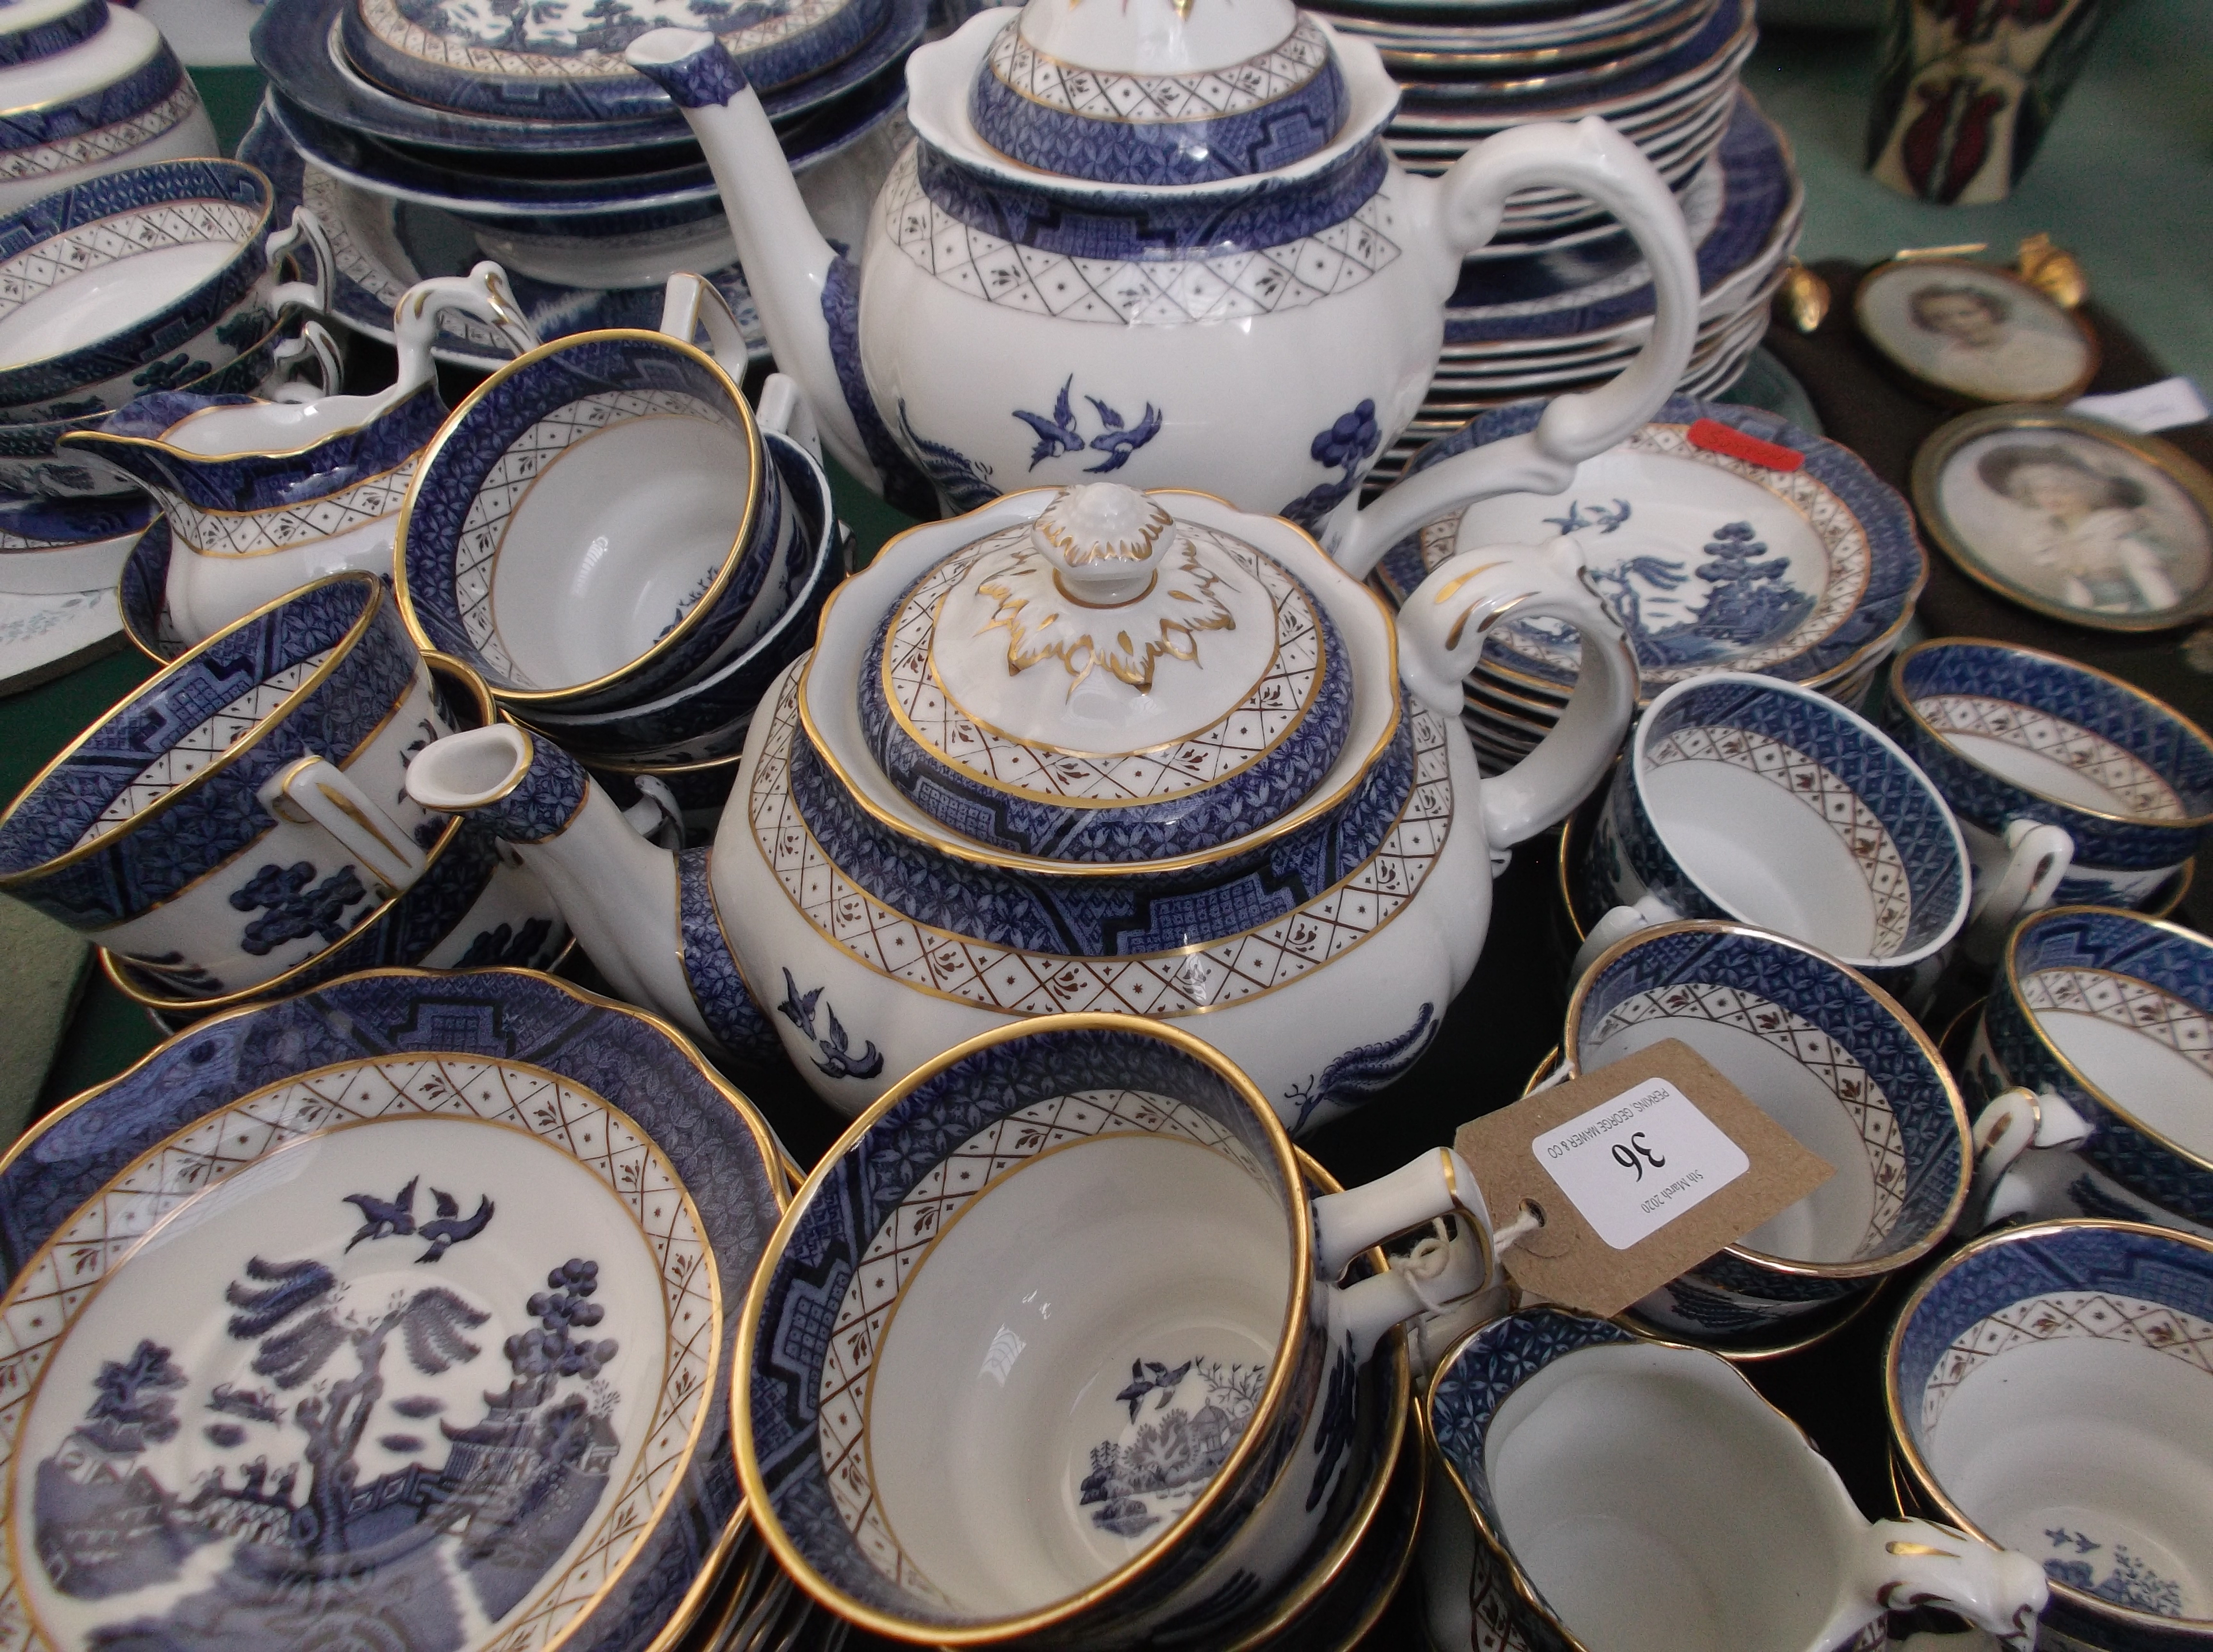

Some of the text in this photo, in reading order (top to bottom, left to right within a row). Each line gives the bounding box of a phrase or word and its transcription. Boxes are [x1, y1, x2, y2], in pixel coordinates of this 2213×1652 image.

[1596, 1107, 1634, 1132] GEORGE
[1560, 1141, 1570, 1151] &
[1567, 1125, 1601, 1148] MAWER
[1547, 1145, 1563, 1159] CO
[1612, 1132, 1666, 1183] 36
[1641, 1169, 1703, 1214] 5th March 2020
